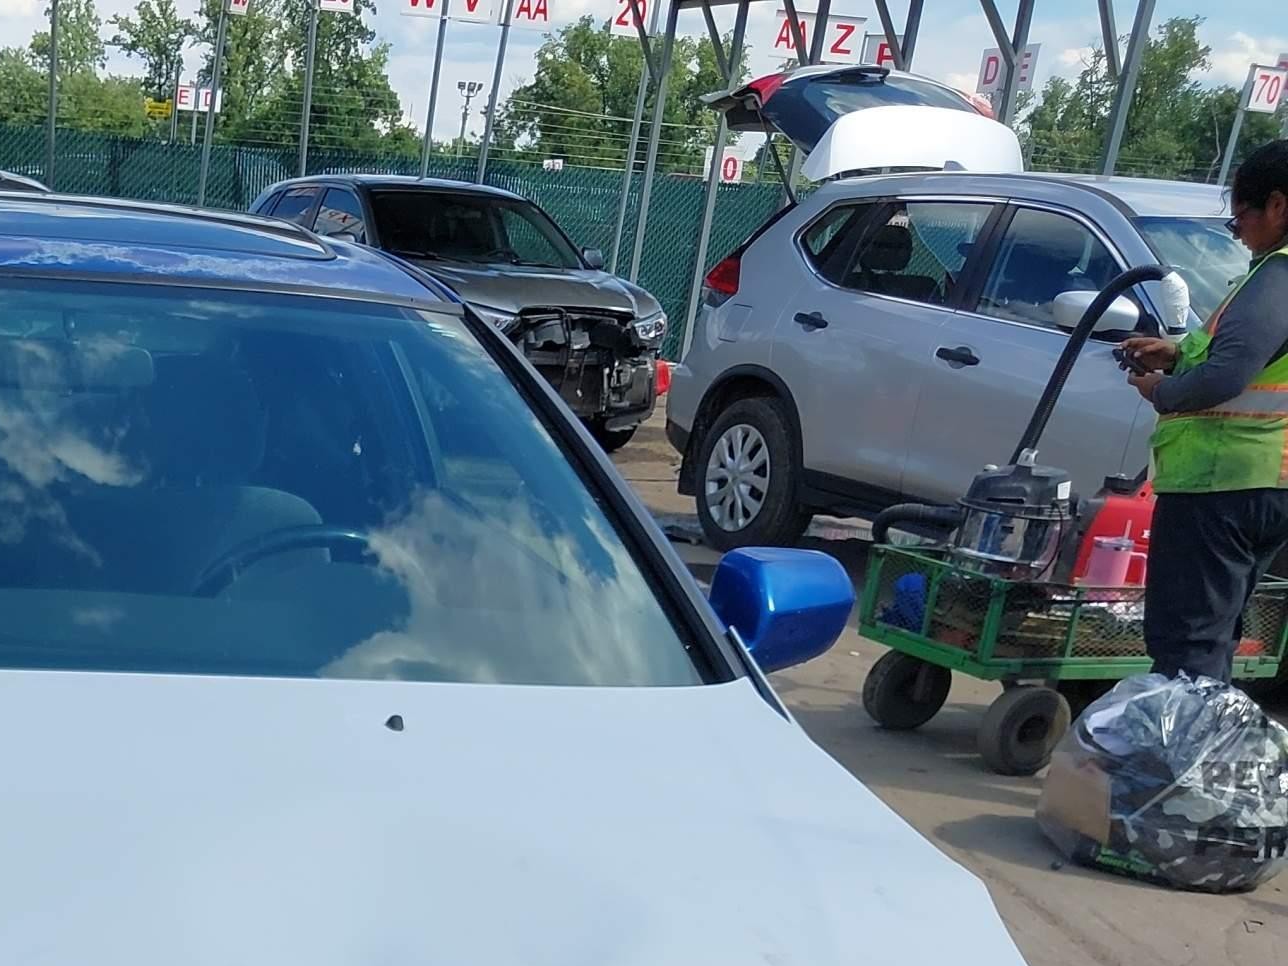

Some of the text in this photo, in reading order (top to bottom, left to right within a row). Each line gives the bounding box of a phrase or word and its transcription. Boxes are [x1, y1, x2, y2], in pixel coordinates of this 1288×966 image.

[515, 0, 548, 21] AA
[830, 24, 856, 55] Z
[983, 56, 999, 85] D
[178, 89, 190, 105] E
[1254, 74, 1281, 105] 70
